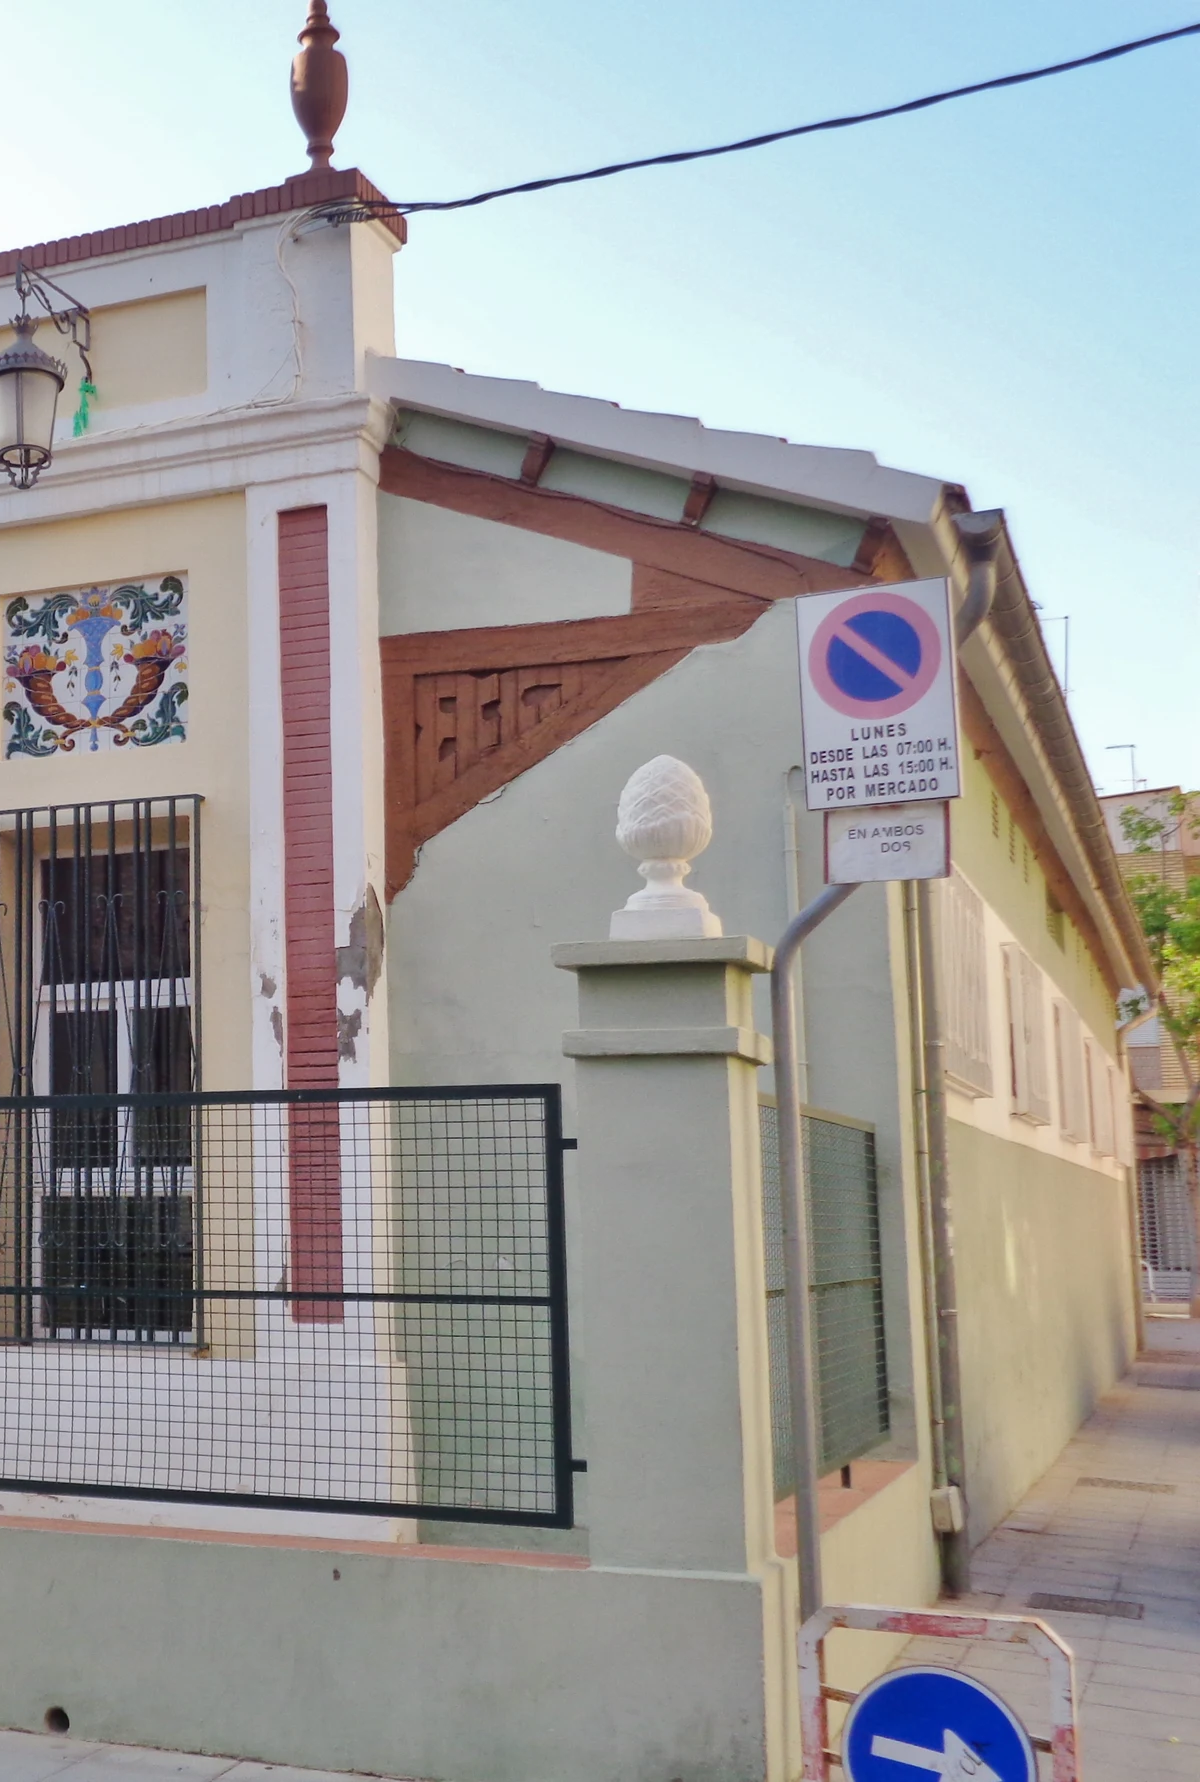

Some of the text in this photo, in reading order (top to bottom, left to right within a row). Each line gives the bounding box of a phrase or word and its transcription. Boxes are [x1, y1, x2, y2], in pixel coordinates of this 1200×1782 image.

[851, 723, 907, 741] LUNES
[810, 737, 952, 765] DESDE LAS 07:00 H.
[811, 756, 954, 784] HASTA LAS 15:00 H.
[826, 777, 939, 801] POR MERCADO
[848, 824, 925, 840] EN AMBOS
